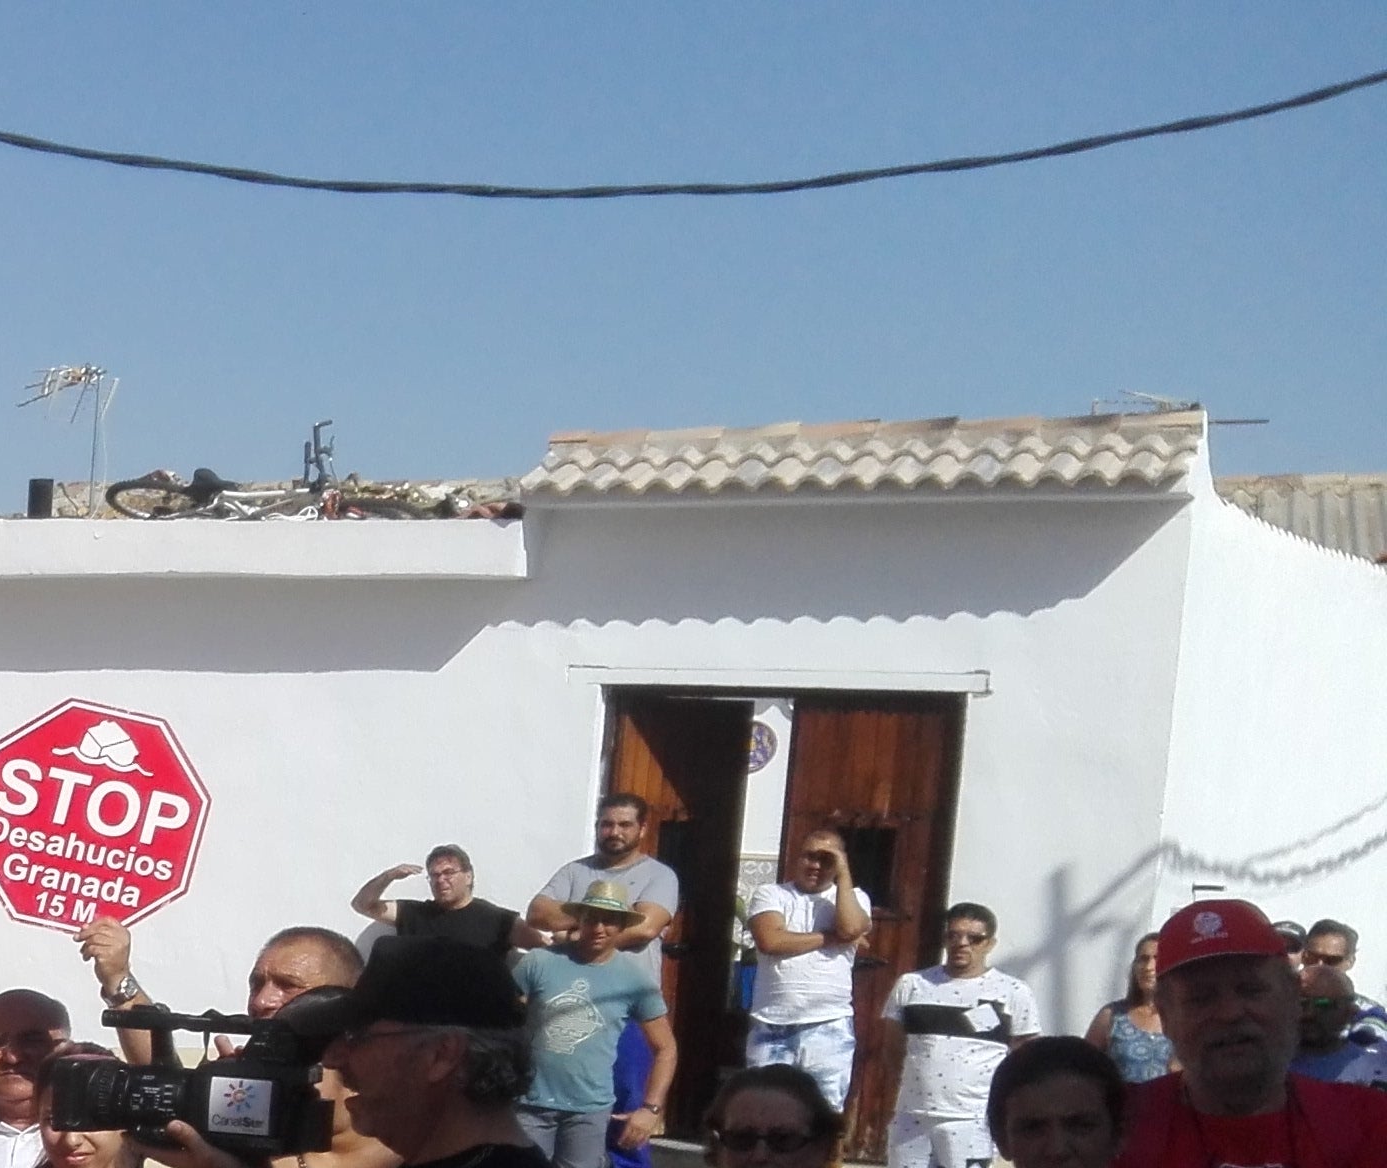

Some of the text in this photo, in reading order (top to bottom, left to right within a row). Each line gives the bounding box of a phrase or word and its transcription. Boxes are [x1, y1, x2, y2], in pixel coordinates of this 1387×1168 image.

[2, 852, 141, 908] Granada
[35, 891, 97, 924] 15 M
